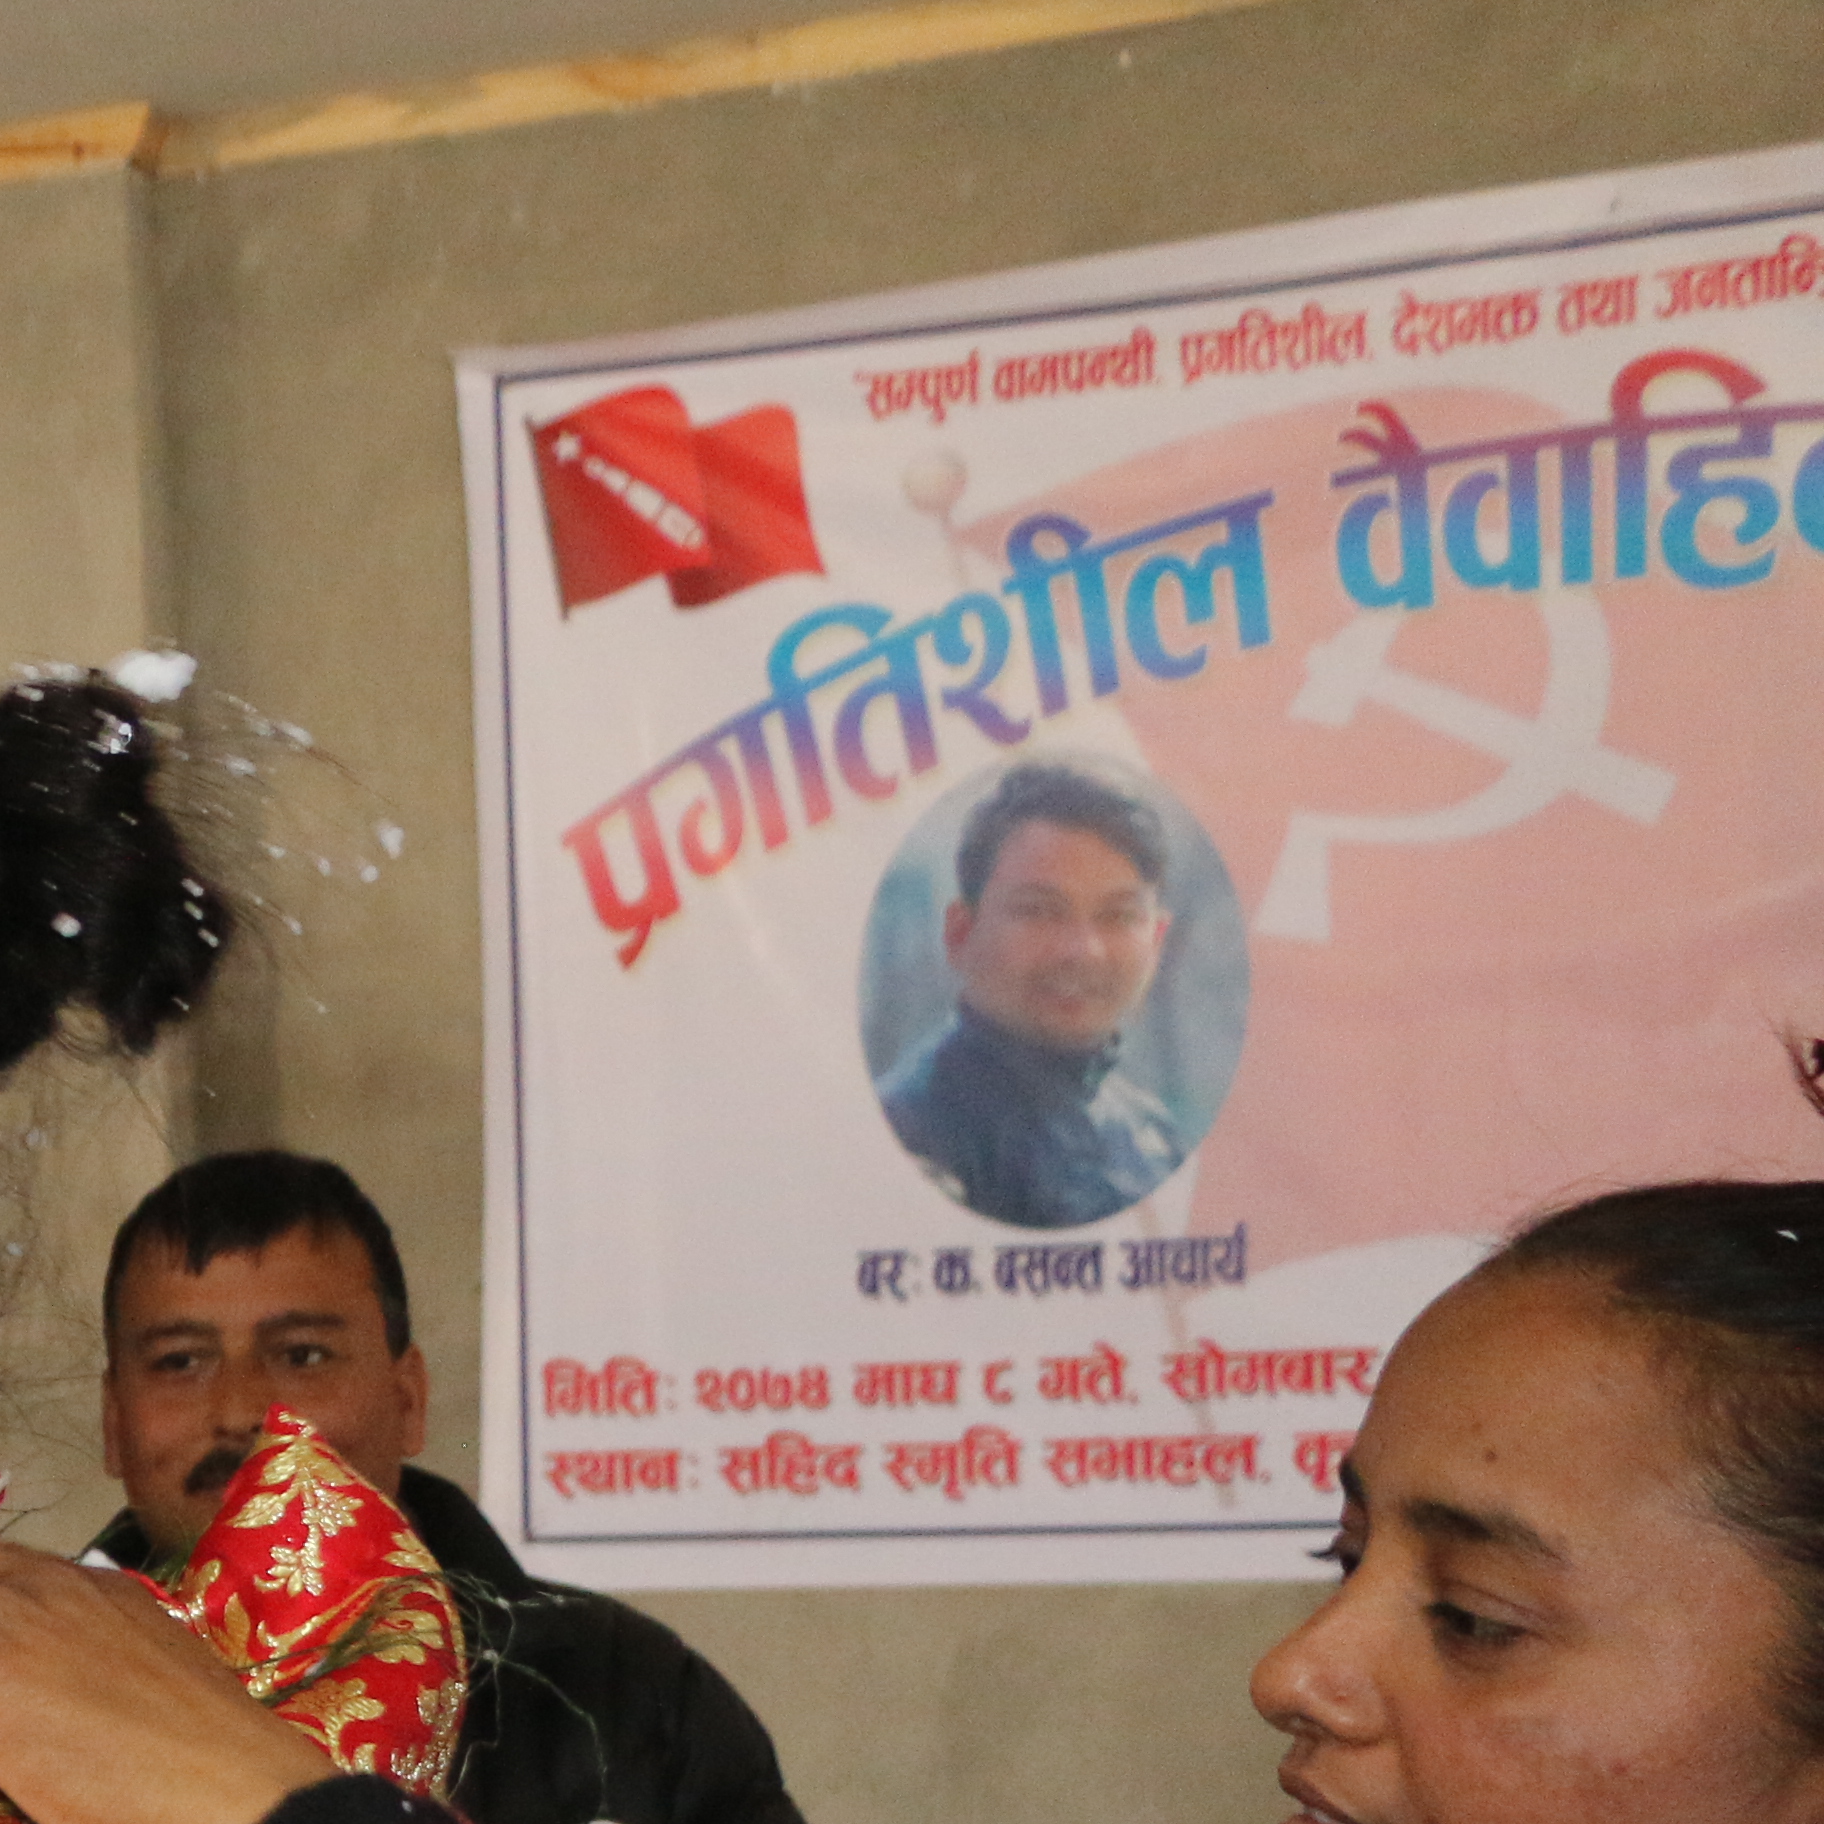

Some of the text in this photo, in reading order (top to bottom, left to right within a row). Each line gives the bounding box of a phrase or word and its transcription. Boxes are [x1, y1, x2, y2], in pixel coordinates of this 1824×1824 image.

[1555, 273, 1639, 336] तथा
[560, 488, 1276, 972] प्रगतिशील
[1118, 1220, 1248, 1292] आचार्य
[694, 1364, 831, 1413] २०७४
[853, 1359, 959, 1407] माघ
[983, 1358, 1013, 1404] ८
[718, 1428, 861, 1496] सहिद
[882, 1423, 1021, 1501] स्मृति
